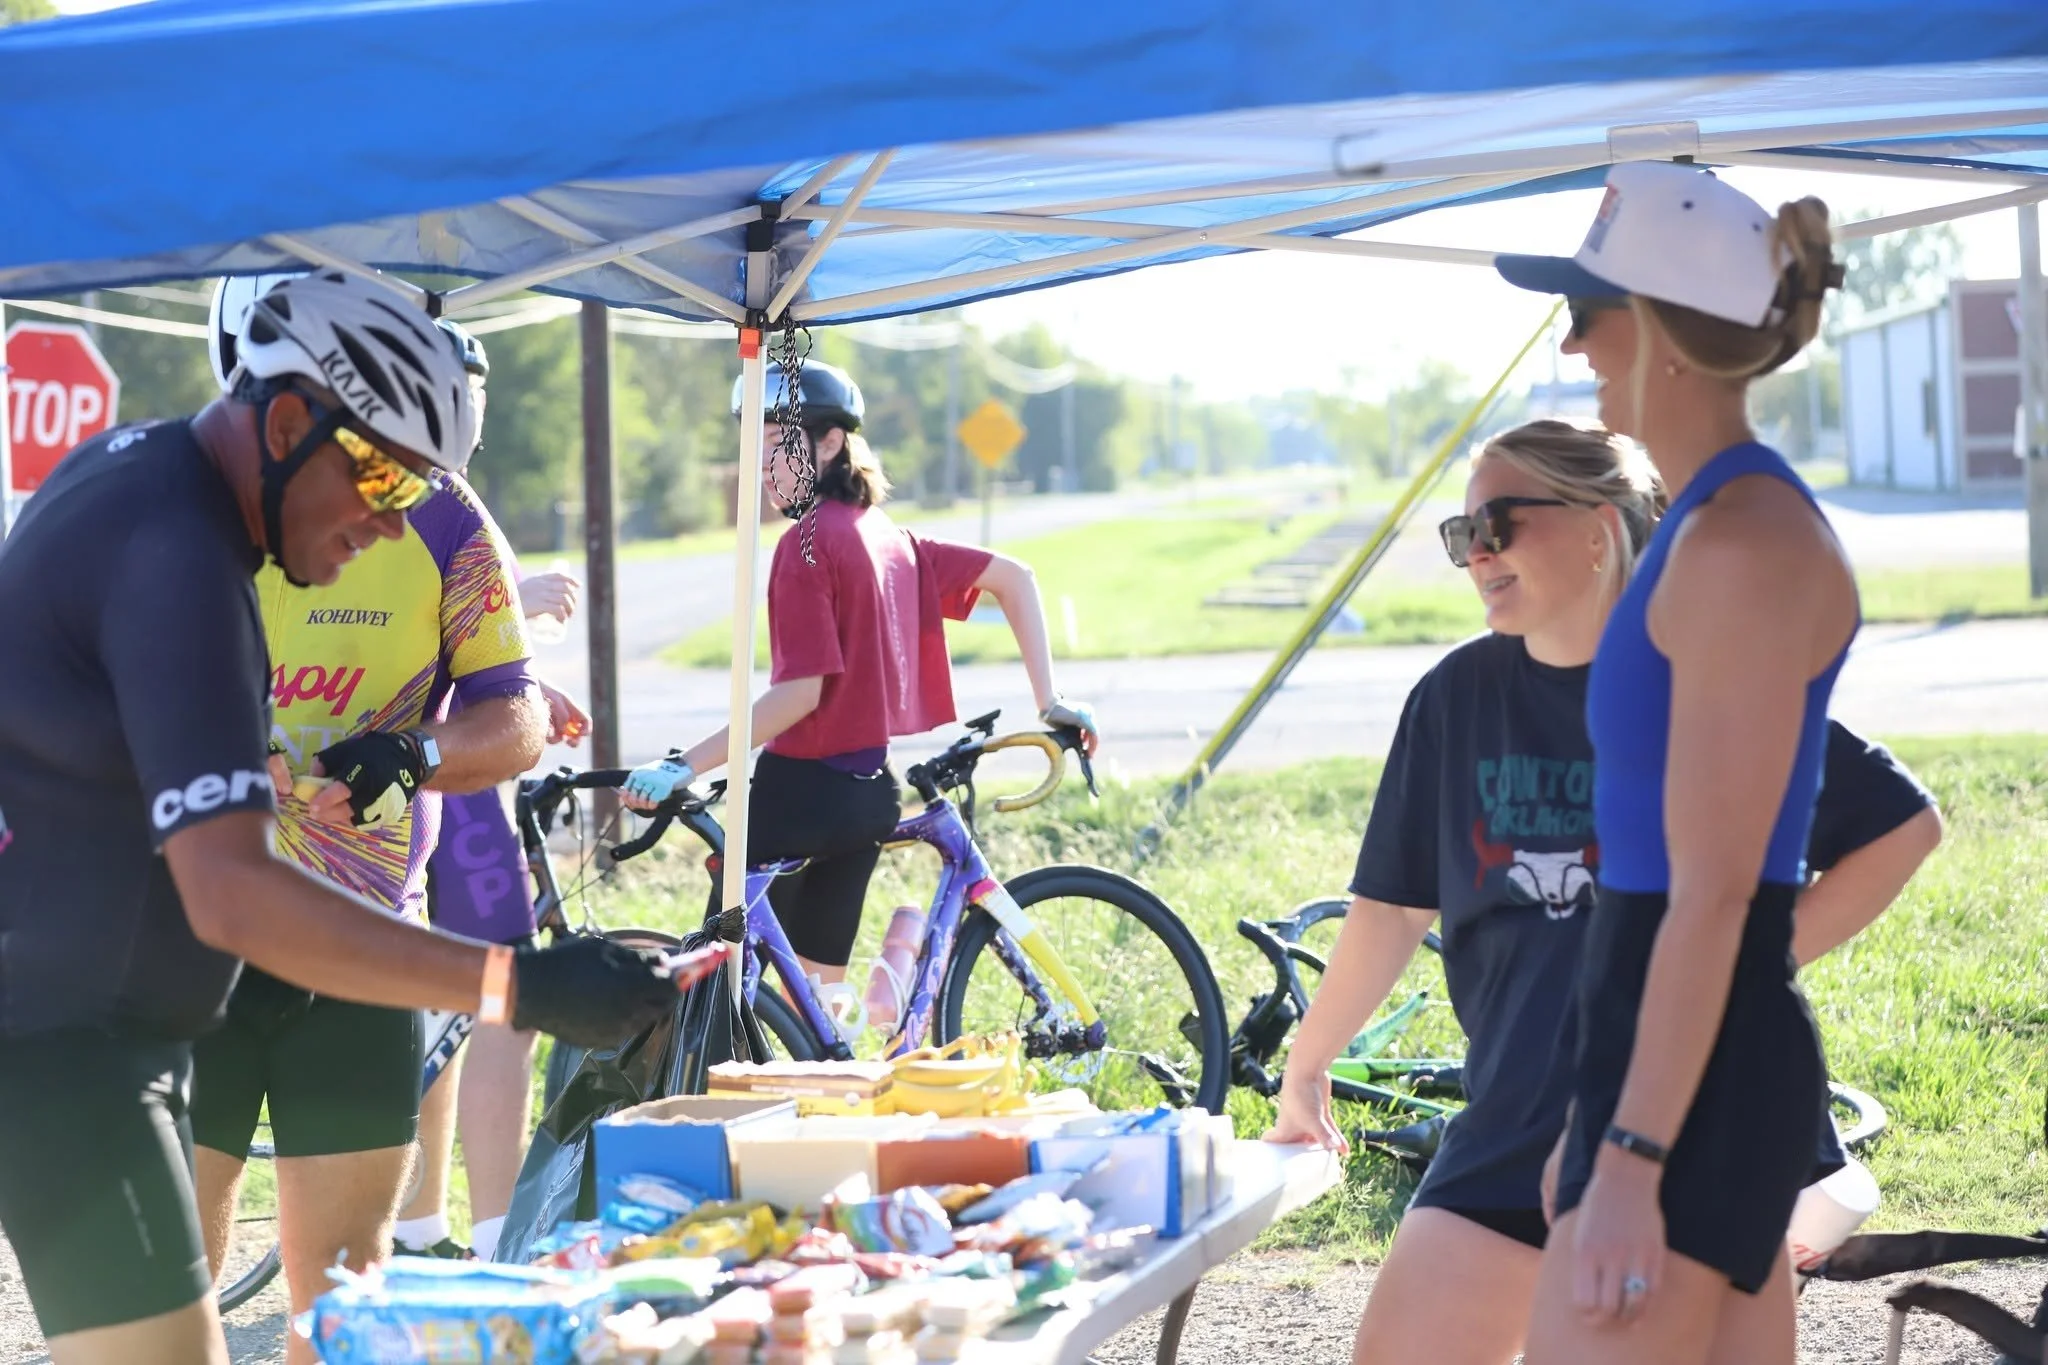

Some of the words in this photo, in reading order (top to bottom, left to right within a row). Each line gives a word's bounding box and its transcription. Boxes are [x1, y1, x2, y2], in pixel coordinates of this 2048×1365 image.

[8, 377, 104, 449] TOP
[319, 350, 383, 420] KASK
[306, 608, 393, 627] KOHLWEY
